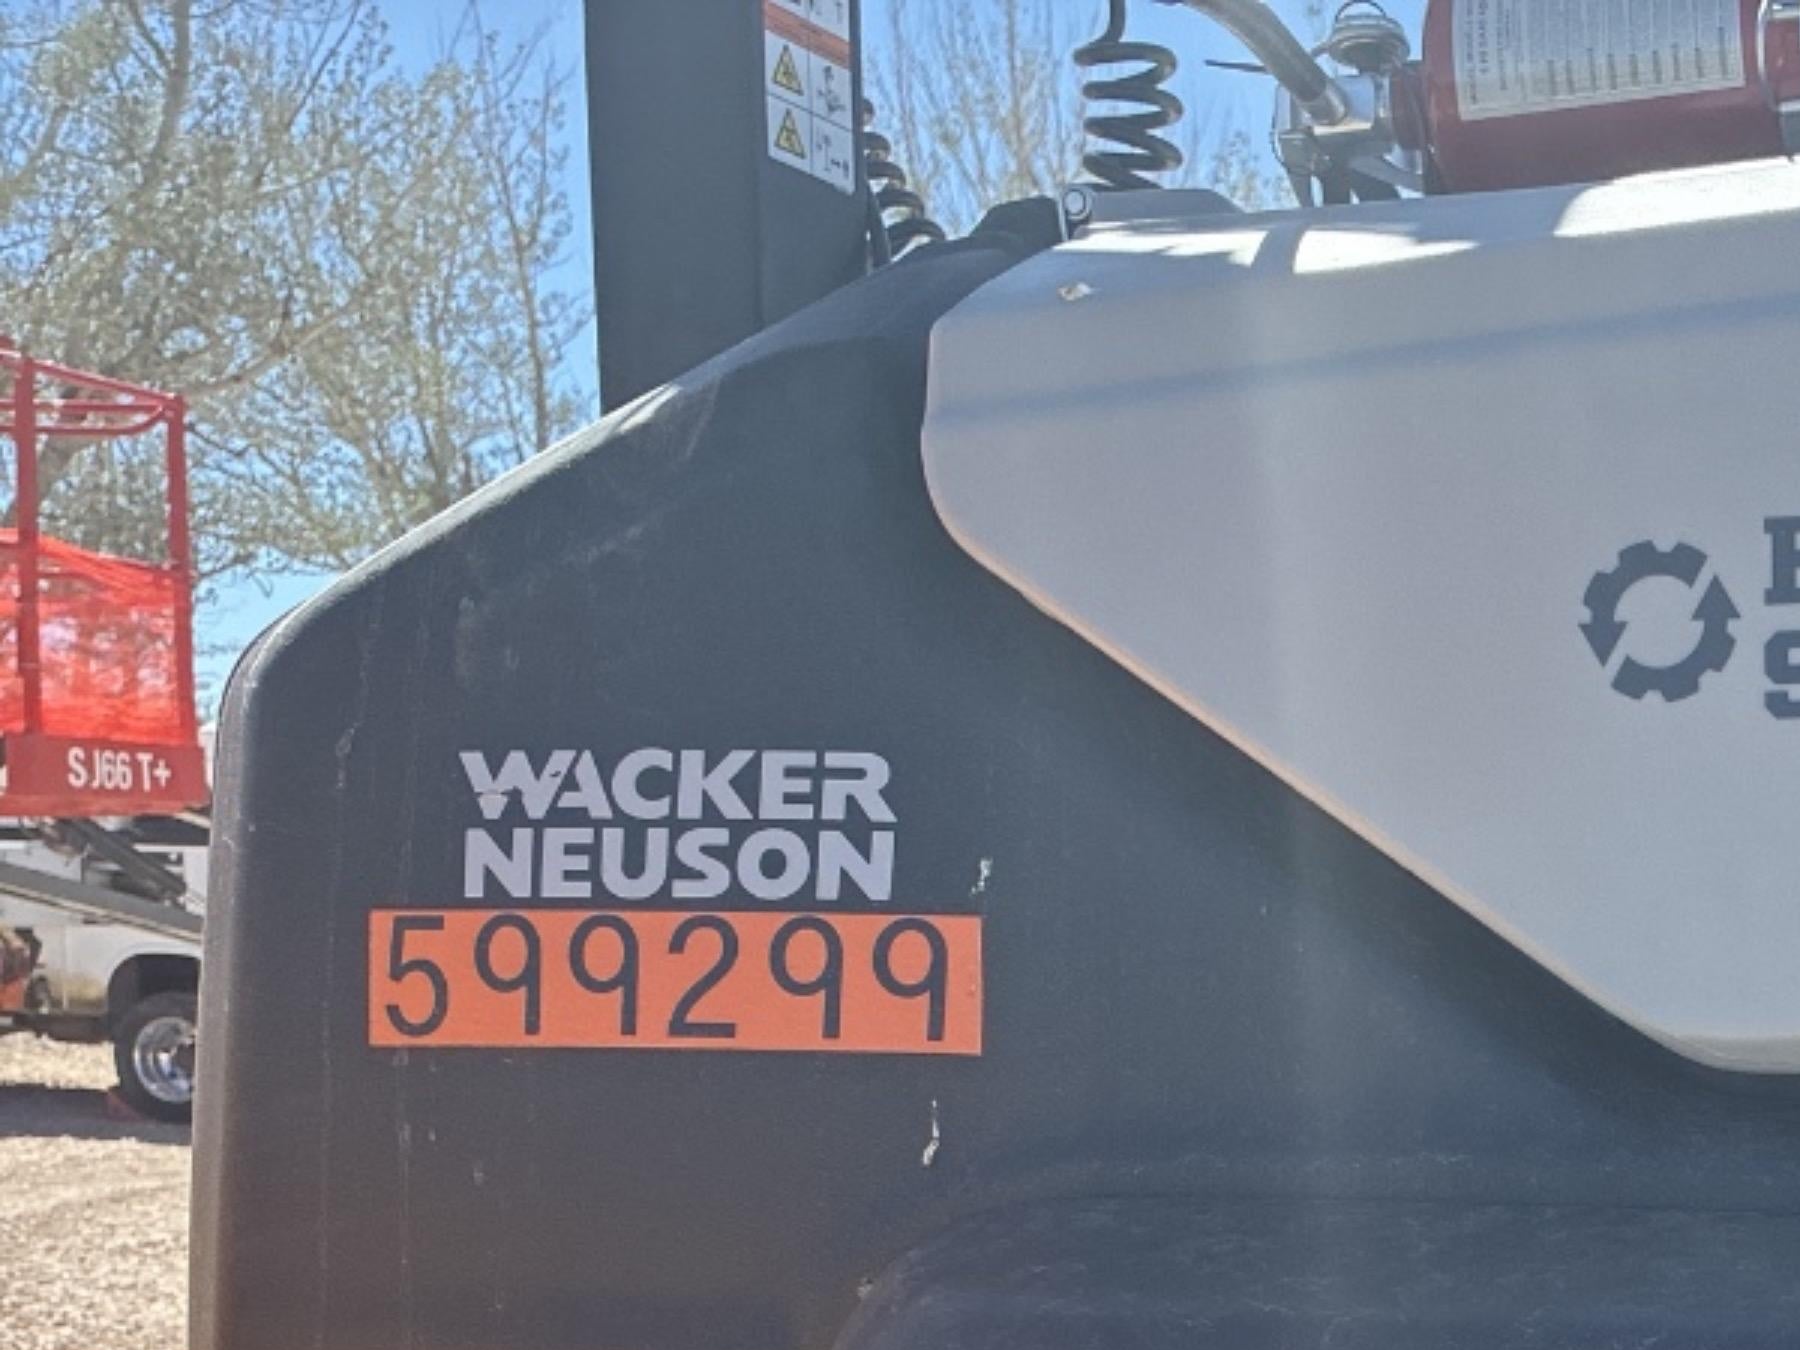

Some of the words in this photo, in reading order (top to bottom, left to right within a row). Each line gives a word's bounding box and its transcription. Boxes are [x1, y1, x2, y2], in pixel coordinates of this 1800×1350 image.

[67, 745, 134, 791] SJ66
[459, 747, 898, 823] WACKER
[463, 827, 896, 901] NEUSON
[384, 913, 949, 1042] 599299
